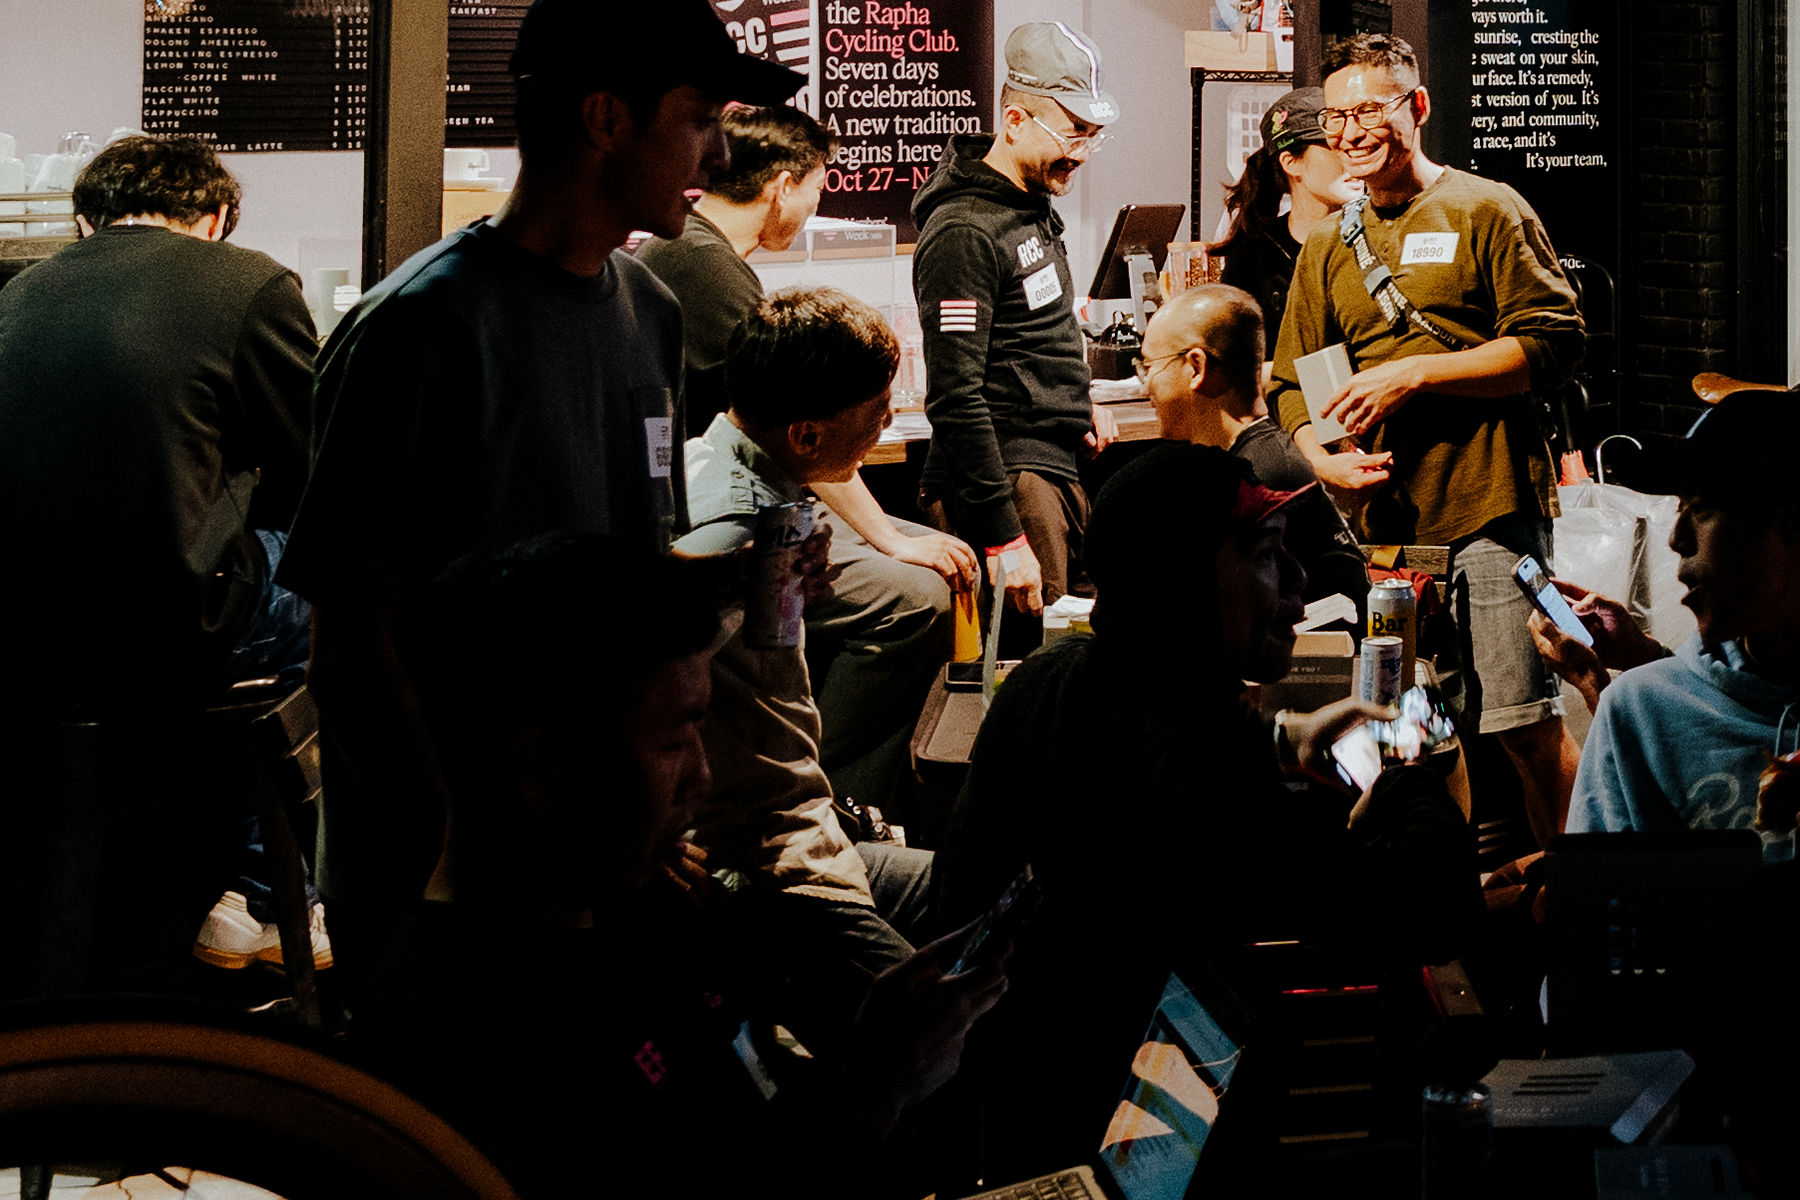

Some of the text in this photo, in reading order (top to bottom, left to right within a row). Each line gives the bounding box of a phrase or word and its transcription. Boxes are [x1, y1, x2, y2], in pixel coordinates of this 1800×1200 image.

[825, 2, 930, 30] the Rapha
[1498, 8, 1534, 24] worth
[1536, 8, 1548, 24] it.
[199, 27, 258, 35] ESPRESSO
[1474, 28, 1599, 48] sunrise, cresting the
[200, 39, 267, 47] AMERICANO
[825, 29, 960, 59] Cycling Club.
[219, 50, 278, 58] ESPRESSO
[1480, 52, 1516, 65] sweat
[1520, 53, 1535, 65] on
[1539, 52, 1568, 69] your
[1571, 49, 1600, 67] skin,
[825, 57, 939, 89] Seven days
[1472, 69, 1594, 89] ur face. It's a remedy,
[825, 85, 847, 109] of
[849, 85, 977, 109] celebrations.
[1486, 91, 1530, 107] version
[1534, 90, 1550, 106] of
[1551, 93, 1577, 110] you.
[1582, 90, 1600, 106] It's
[826, 112, 982, 136] A new tradition
[1501, 111, 1525, 127] and
[1529, 111, 1600, 130] community,
[1473, 130, 1556, 150] a race, and it's
[897, 138, 943, 164] here
[1526, 152, 1608, 172] It's your team,
[825, 168, 863, 193] Oct
[1016, 236, 1045, 268] RCC
[1372, 611, 1409, 632] Bar
